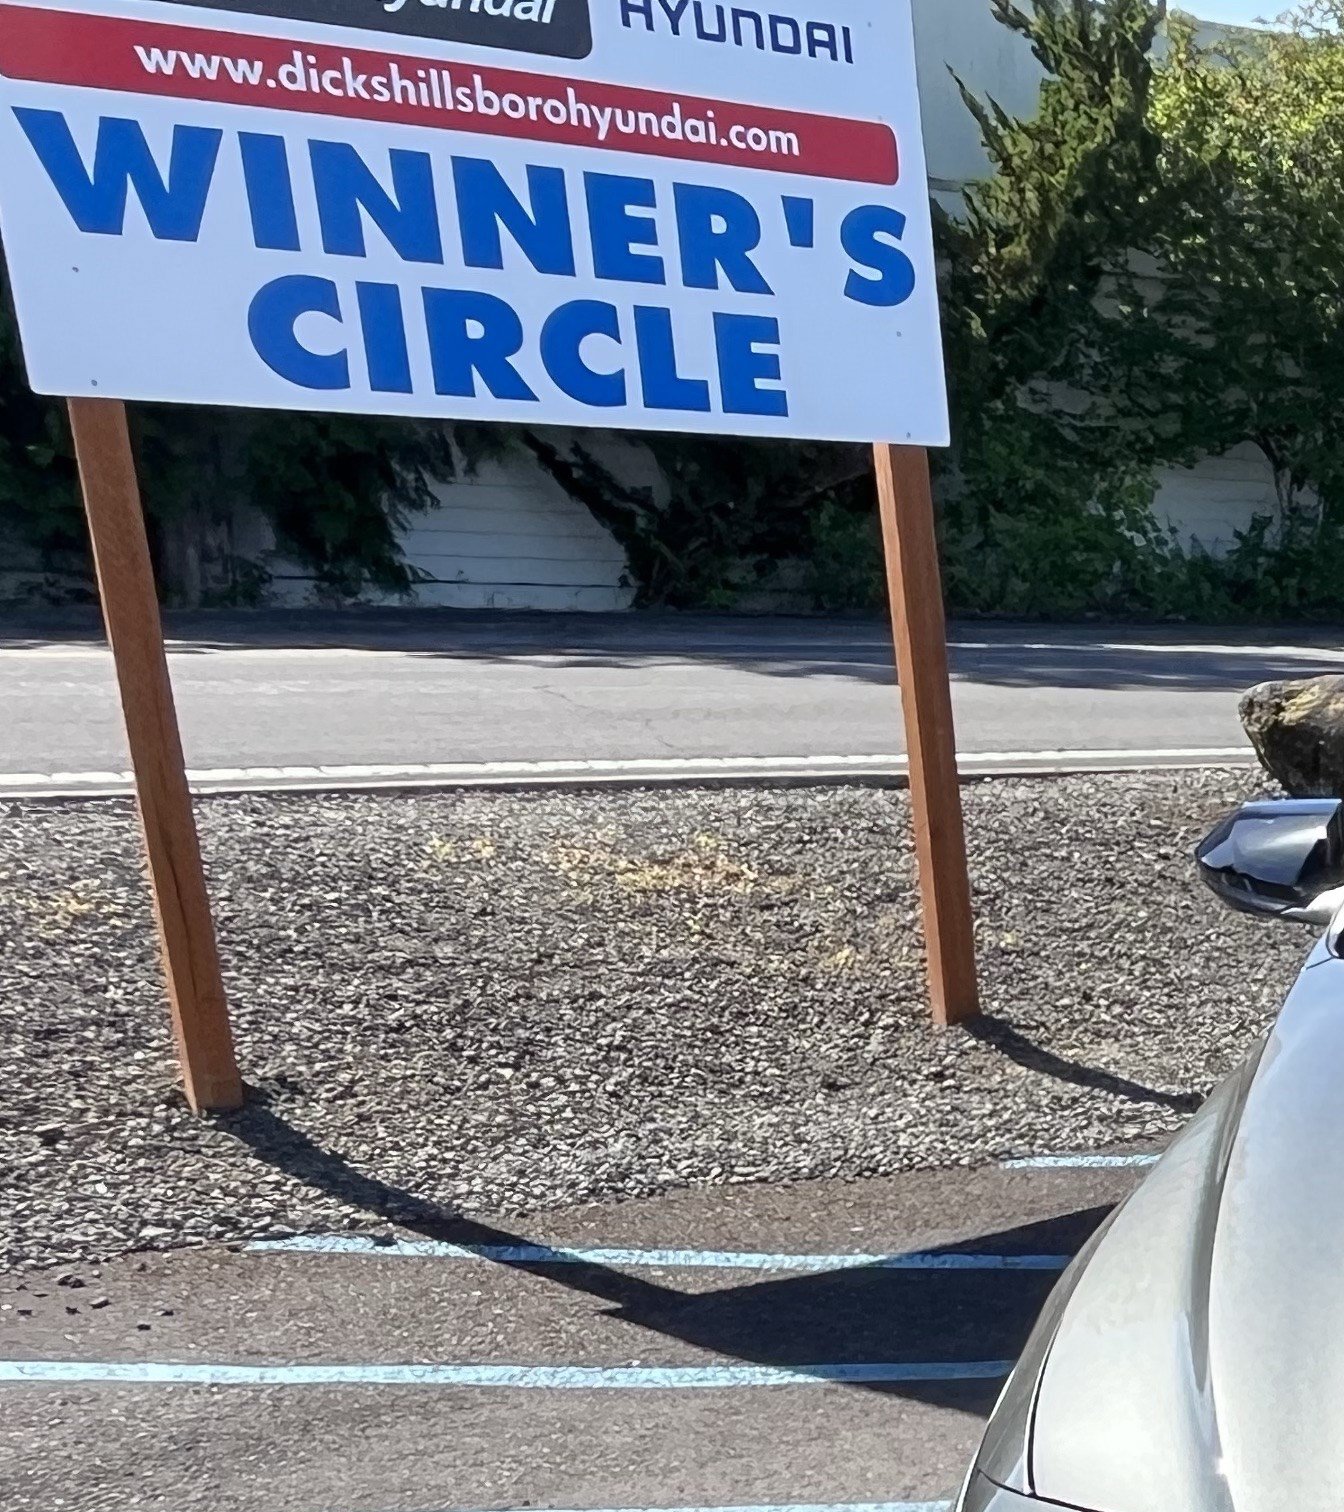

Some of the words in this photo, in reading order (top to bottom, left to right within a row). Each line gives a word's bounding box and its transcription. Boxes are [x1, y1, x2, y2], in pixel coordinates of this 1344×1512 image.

[619, 0, 854, 64] HYUNDAI
[134, 44, 801, 158] www.dickshillsborohyundai.com
[11, 106, 916, 306] WINNER'S
[247, 273, 789, 417] CIRCLE
